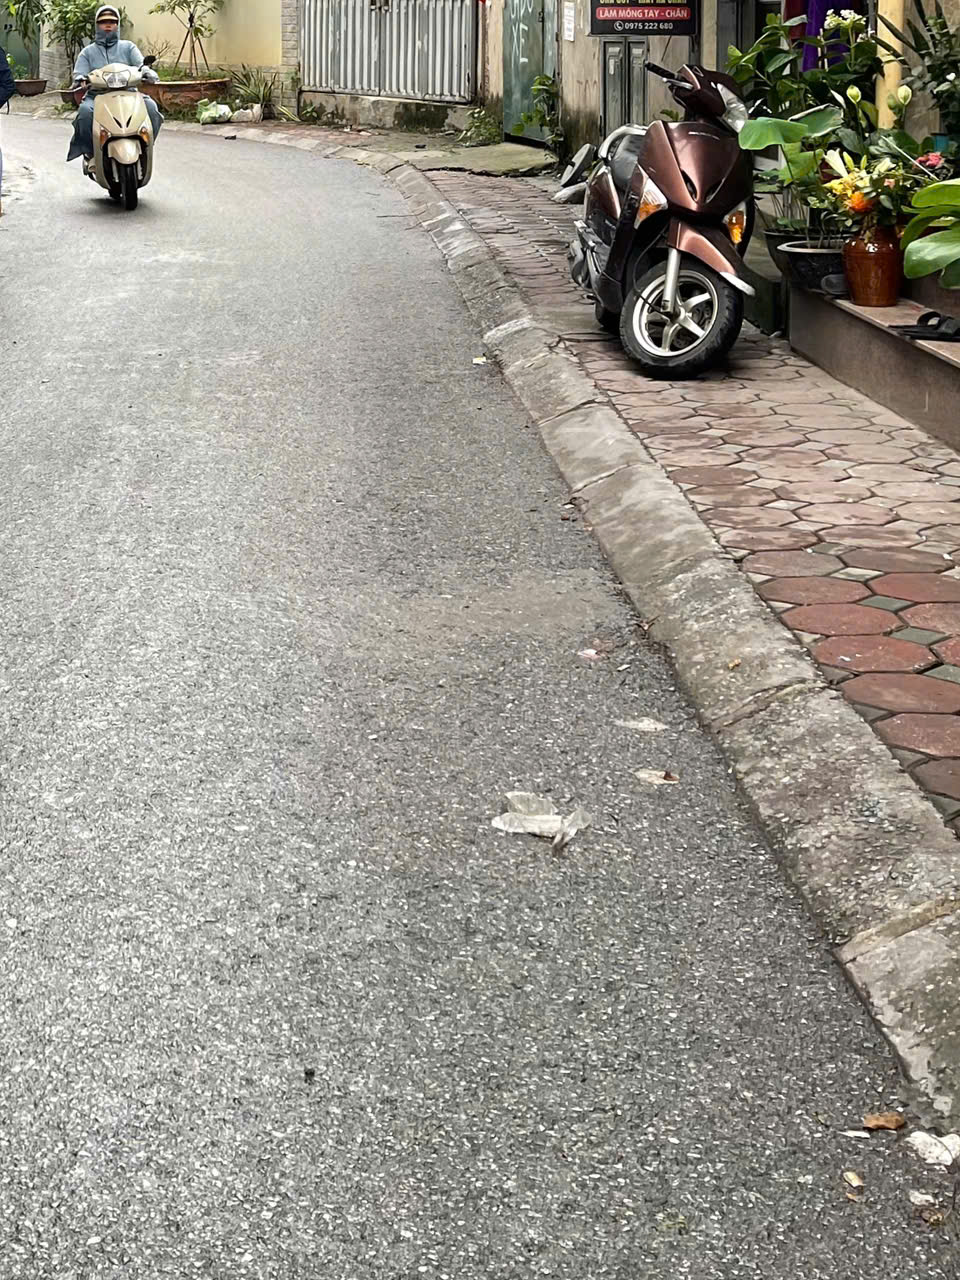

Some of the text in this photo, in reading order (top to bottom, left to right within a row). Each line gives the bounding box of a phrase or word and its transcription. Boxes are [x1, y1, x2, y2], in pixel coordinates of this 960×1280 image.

[599, 8, 688, 18] LÀM MÓNG TAY CHÂN
[624, 22, 673, 30] 0975 222 680
[512, 22, 529, 65] XE
